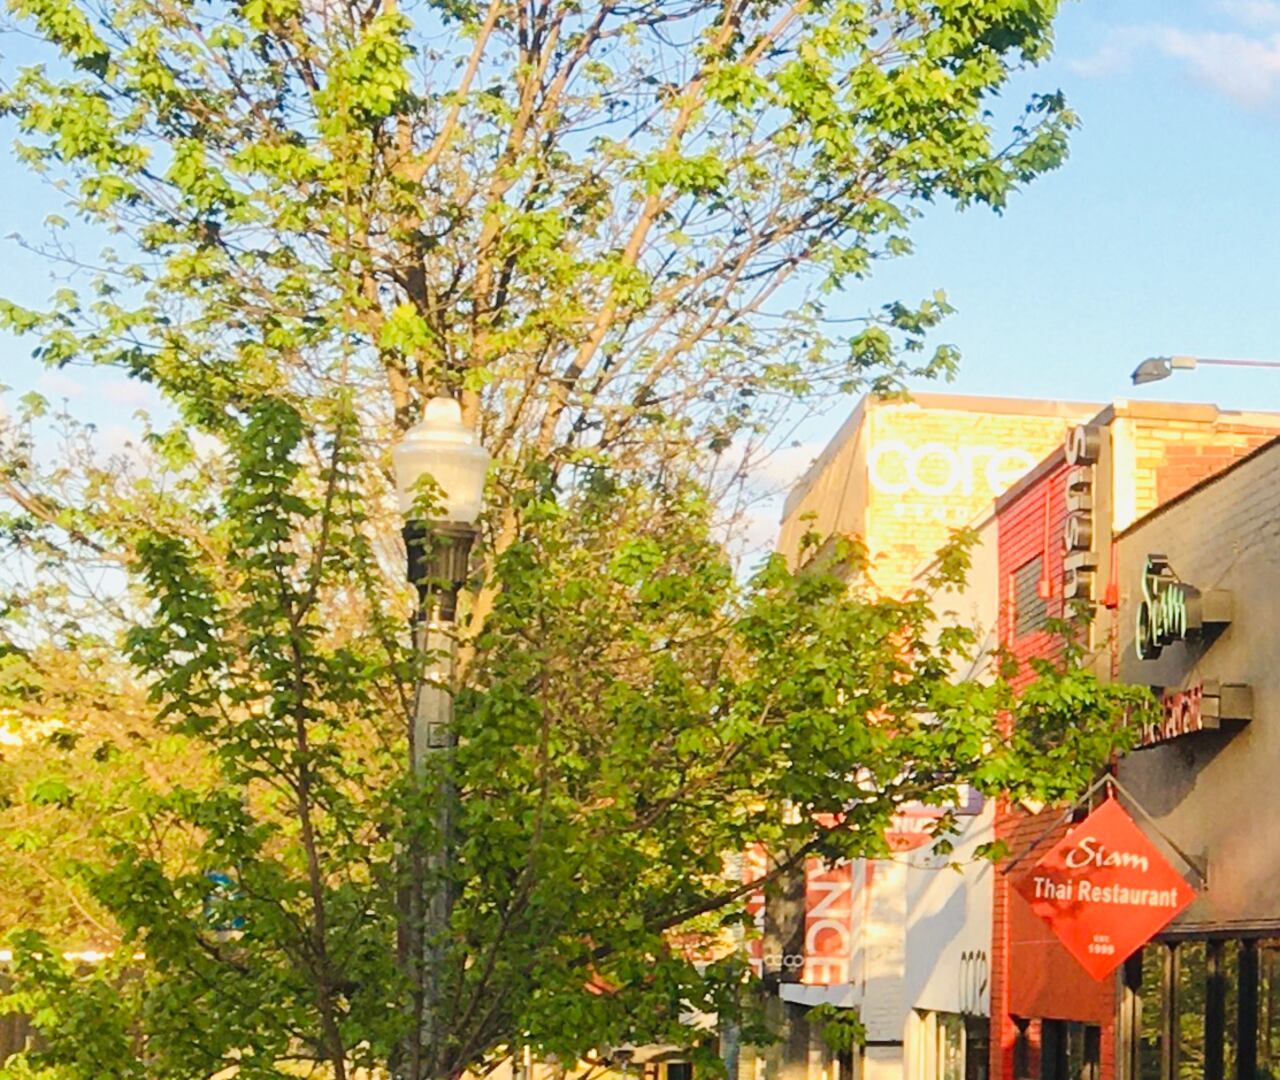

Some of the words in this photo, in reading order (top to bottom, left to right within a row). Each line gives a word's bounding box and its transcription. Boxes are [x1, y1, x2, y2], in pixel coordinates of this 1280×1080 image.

[1065, 836, 1149, 873] Siam
[1033, 877, 1072, 901] Thai
[1078, 879, 1178, 908] Restaurant
